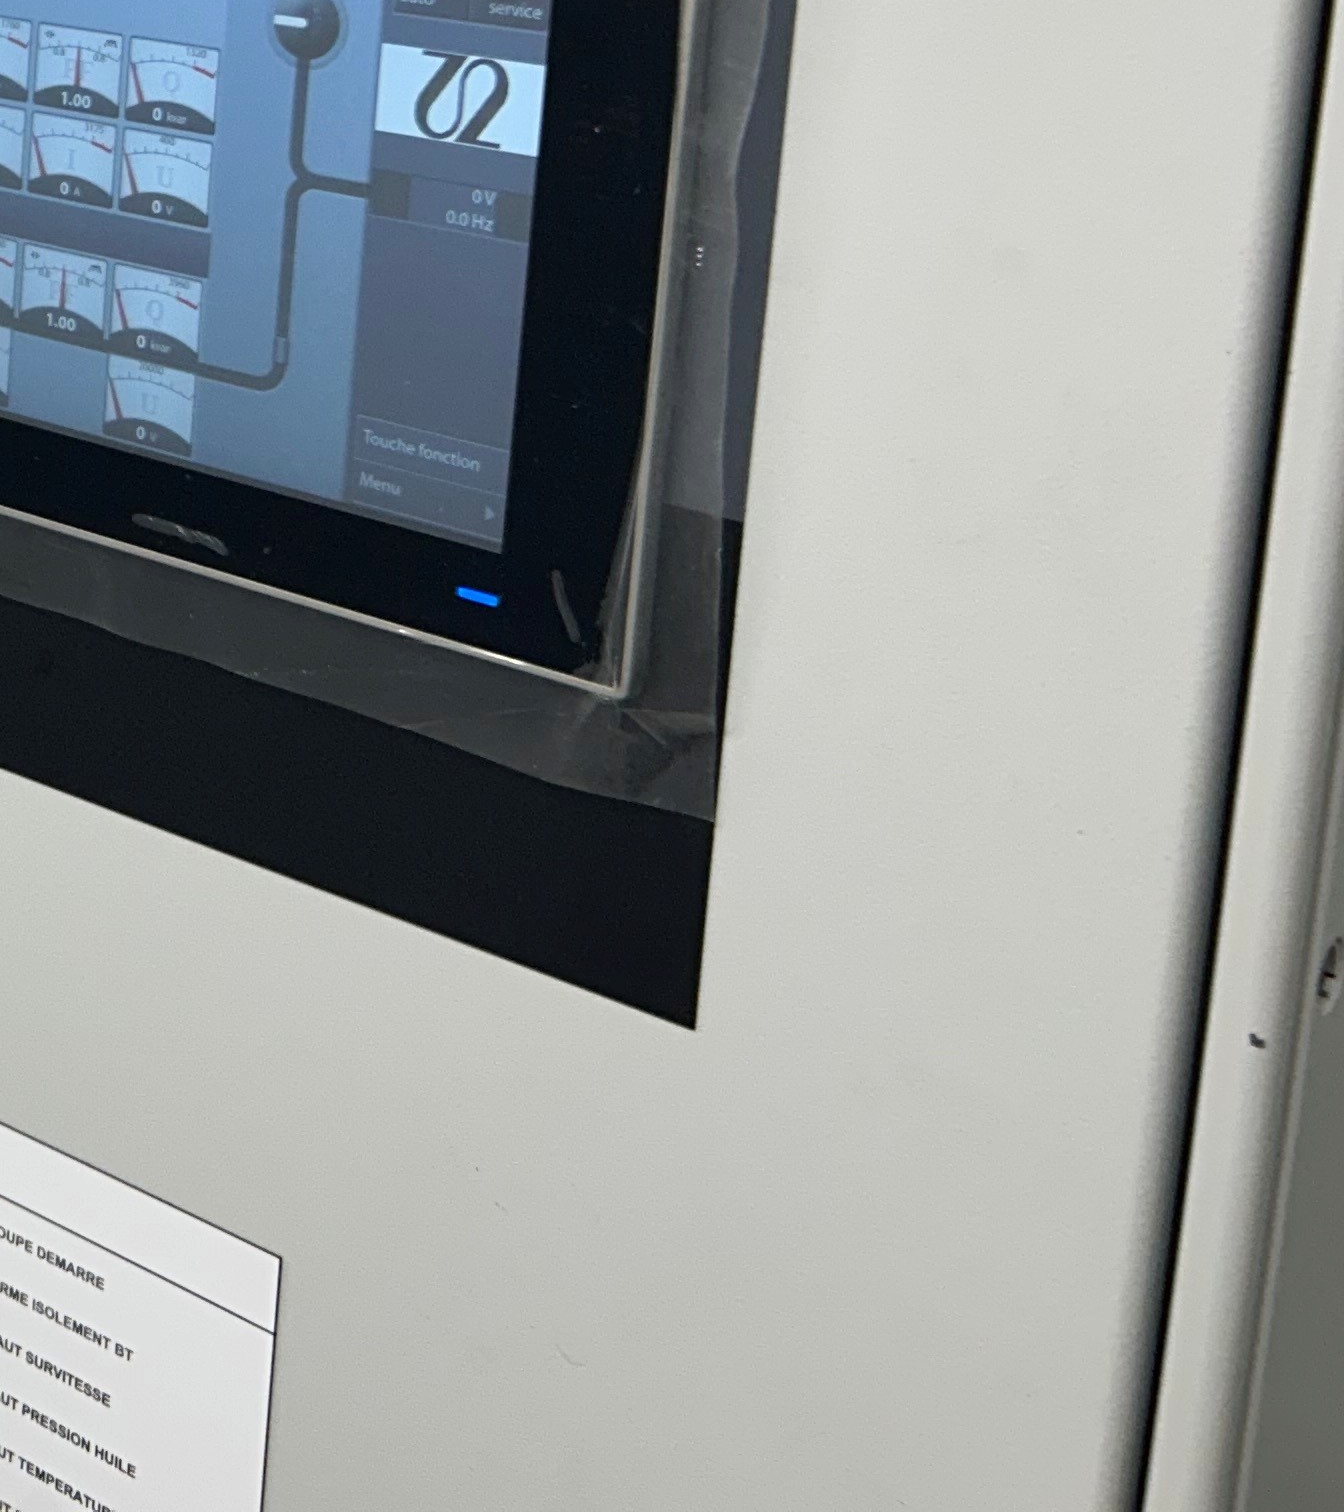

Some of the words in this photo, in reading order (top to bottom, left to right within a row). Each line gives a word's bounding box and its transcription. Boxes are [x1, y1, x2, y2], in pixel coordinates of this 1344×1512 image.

[488, 0, 543, 21] service
[60, 91, 92, 110] 1.00
[152, 107, 162, 122] 0
[59, 181, 69, 196] 0
[471, 189, 482, 205] 0
[483, 190, 497, 205] V
[151, 199, 162, 215] 0
[446, 210, 470, 228] 0.0
[471, 213, 495, 233] Hz
[46, 312, 77, 333] 1.00
[135, 334, 147, 349] 0
[135, 426, 146, 440] 0
[362, 428, 417, 457] Touche
[417, 442, 481, 473] fonction
[358, 471, 401, 497] Menu
[36, 1245, 106, 1292] DEMARRE
[31, 1297, 113, 1352] ISOLEMENT
[114, 1342, 135, 1363] BT
[25, 1350, 112, 1410] SURVITESSE
[21, 1402, 91, 1454] PRESSION
[93, 1444, 137, 1480] HUILE
